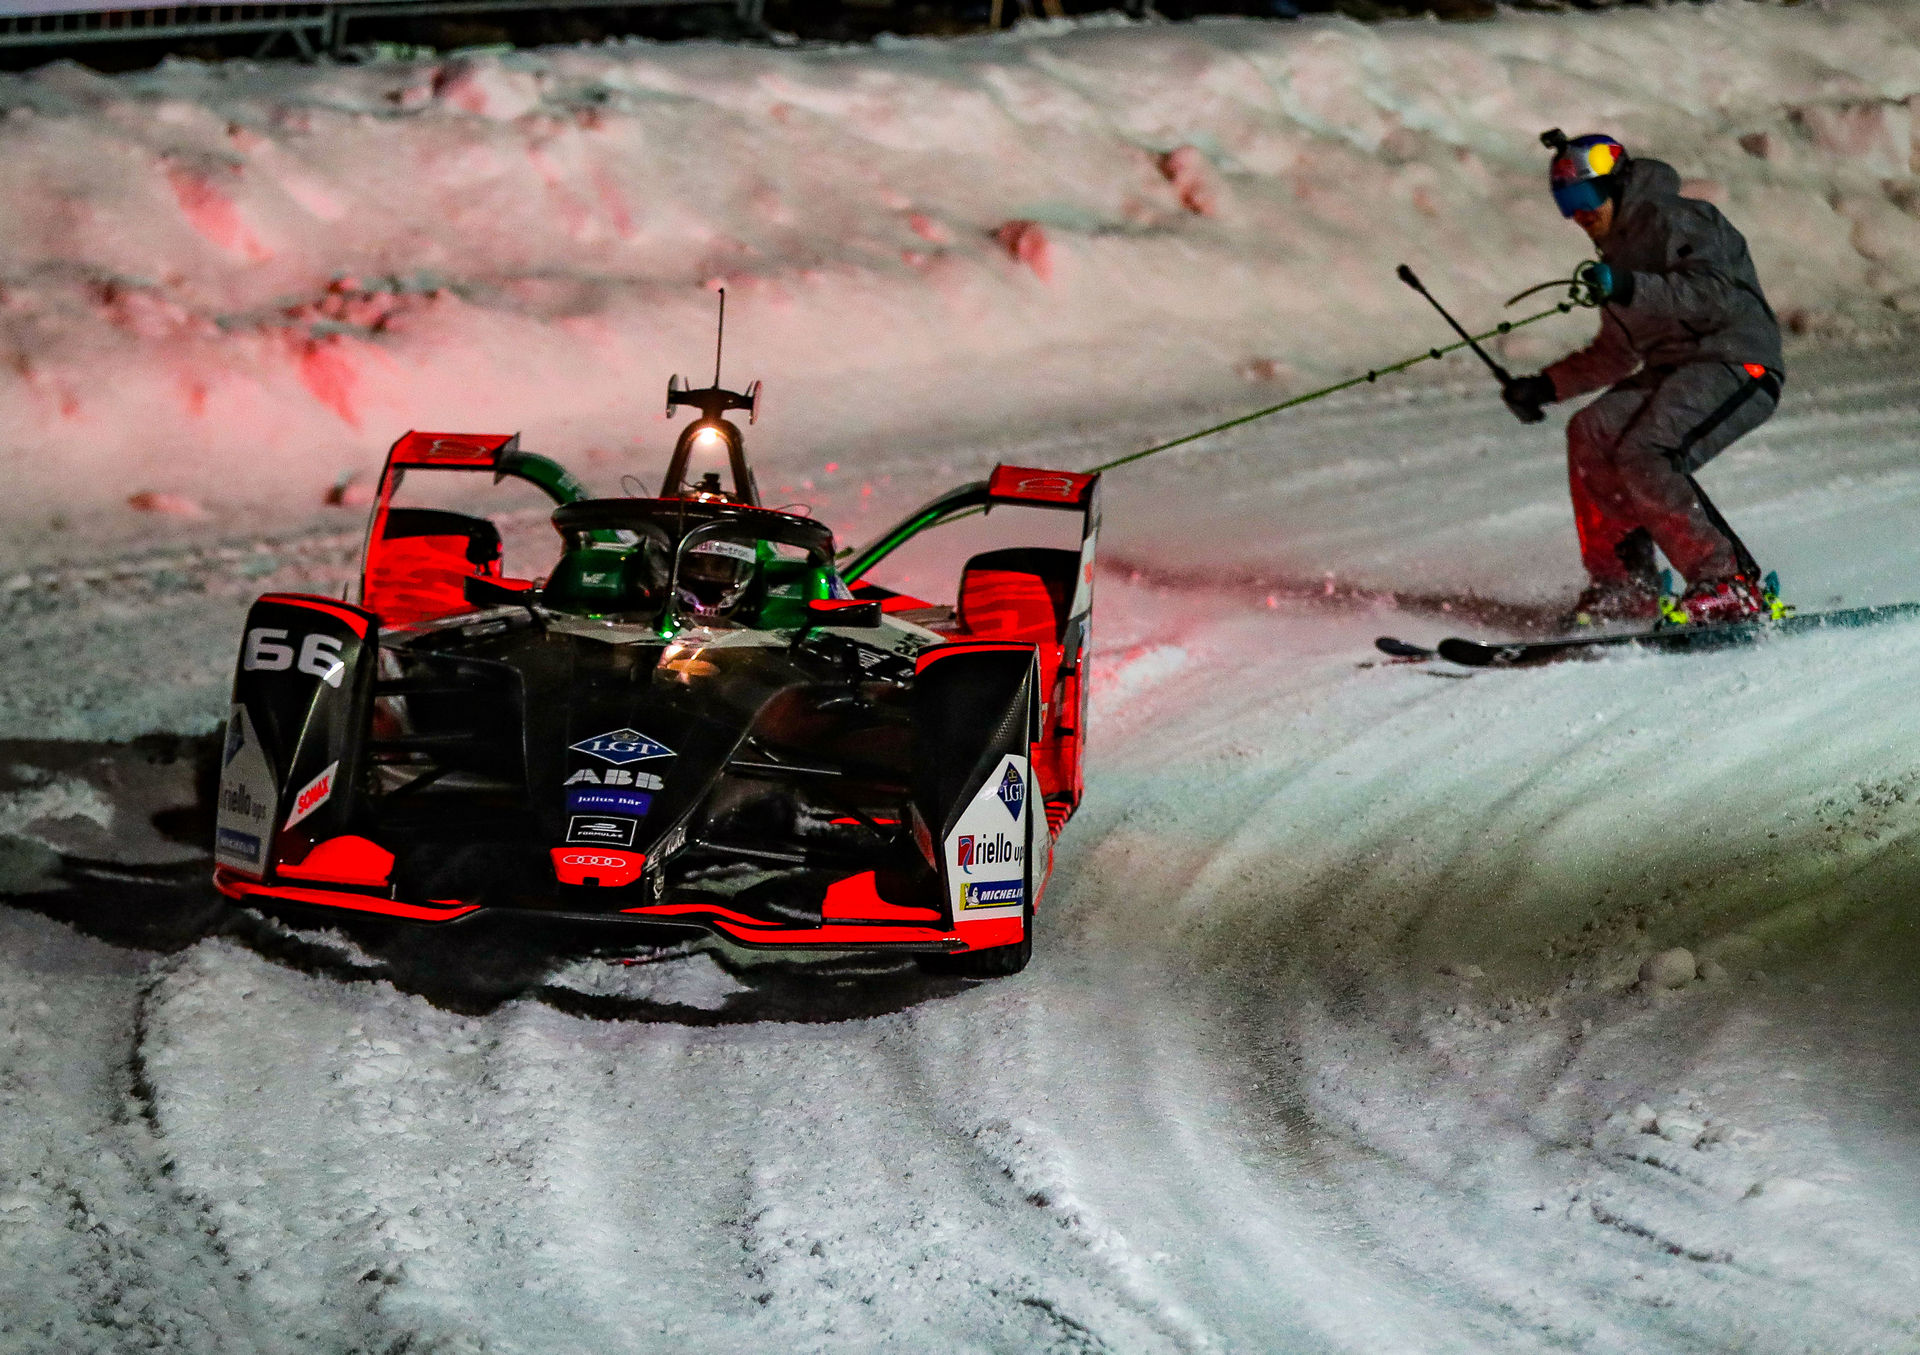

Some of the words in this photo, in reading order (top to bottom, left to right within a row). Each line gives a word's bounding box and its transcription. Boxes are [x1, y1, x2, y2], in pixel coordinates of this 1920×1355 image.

[244, 627, 346, 689] 66
[591, 740, 659, 755] LGT
[563, 768, 665, 791] ABB
[578, 796, 615, 804] Julius
[618, 797, 643, 806] Bär
[975, 832, 1011, 865] riello
